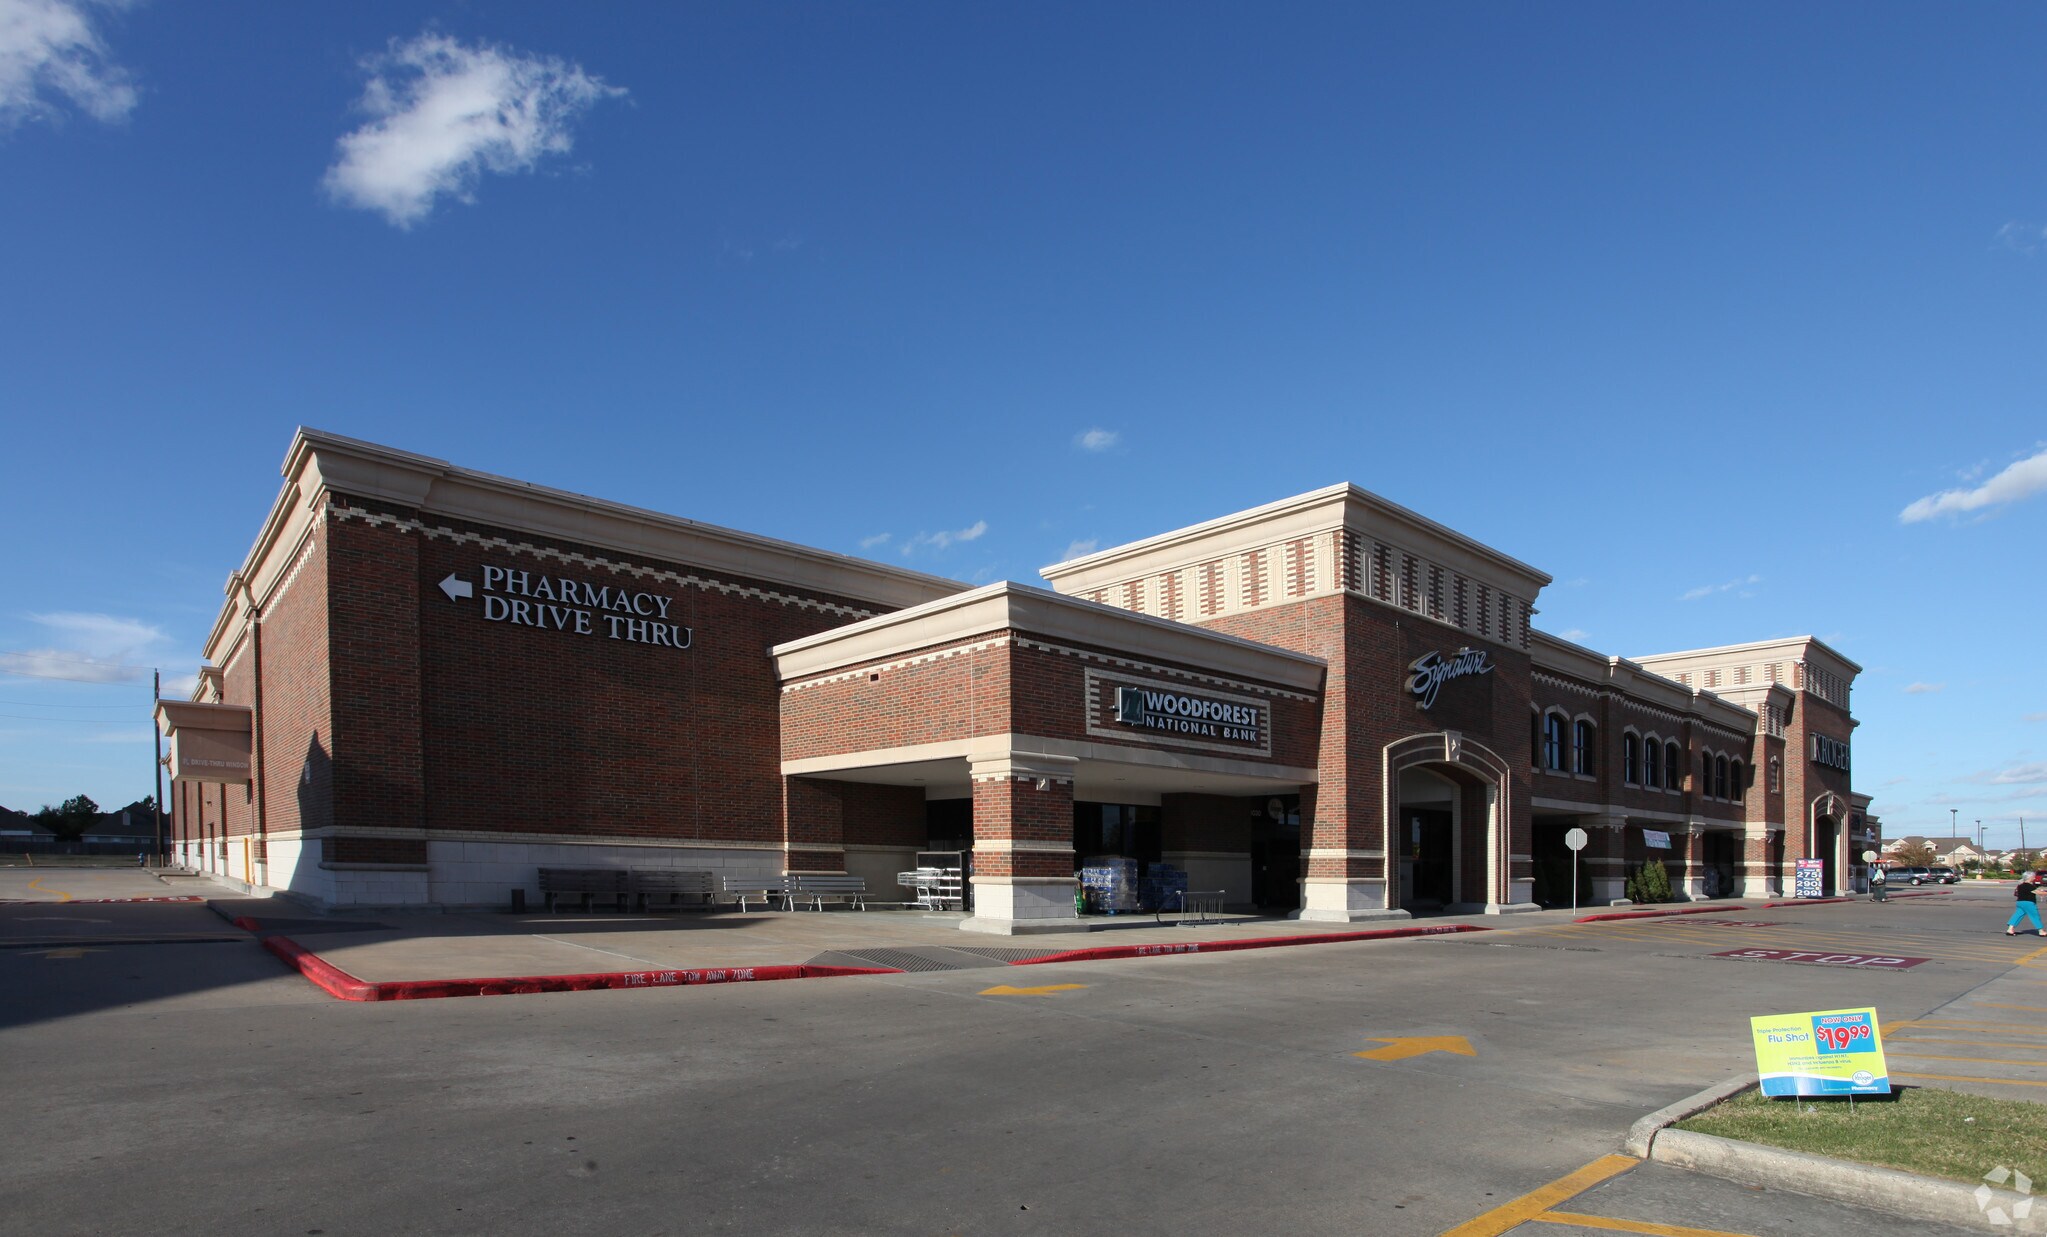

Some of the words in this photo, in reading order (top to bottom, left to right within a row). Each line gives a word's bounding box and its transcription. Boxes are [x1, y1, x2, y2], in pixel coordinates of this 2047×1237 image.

[481, 564, 673, 619] PHARMACY
[481, 594, 593, 635] DRIVE
[603, 614, 693, 649] THRU
[1411, 649, 1496, 710] Signature
[1144, 691, 1257, 726] WOODFOREST
[1145, 716, 1217, 736] NATIONAL
[1223, 727, 1257, 742] BANK
[1729, 951, 1905, 965] STOP
[624, 973, 647, 985] FIRE
[651, 971, 678, 983] LANE
[682, 971, 700, 981] TOW
[706, 970, 726, 980] AWAY
[731, 968, 755, 979] ZONE
[1768, 1034, 1783, 1043] Flu
[1785, 1033, 1809, 1042] Shot
